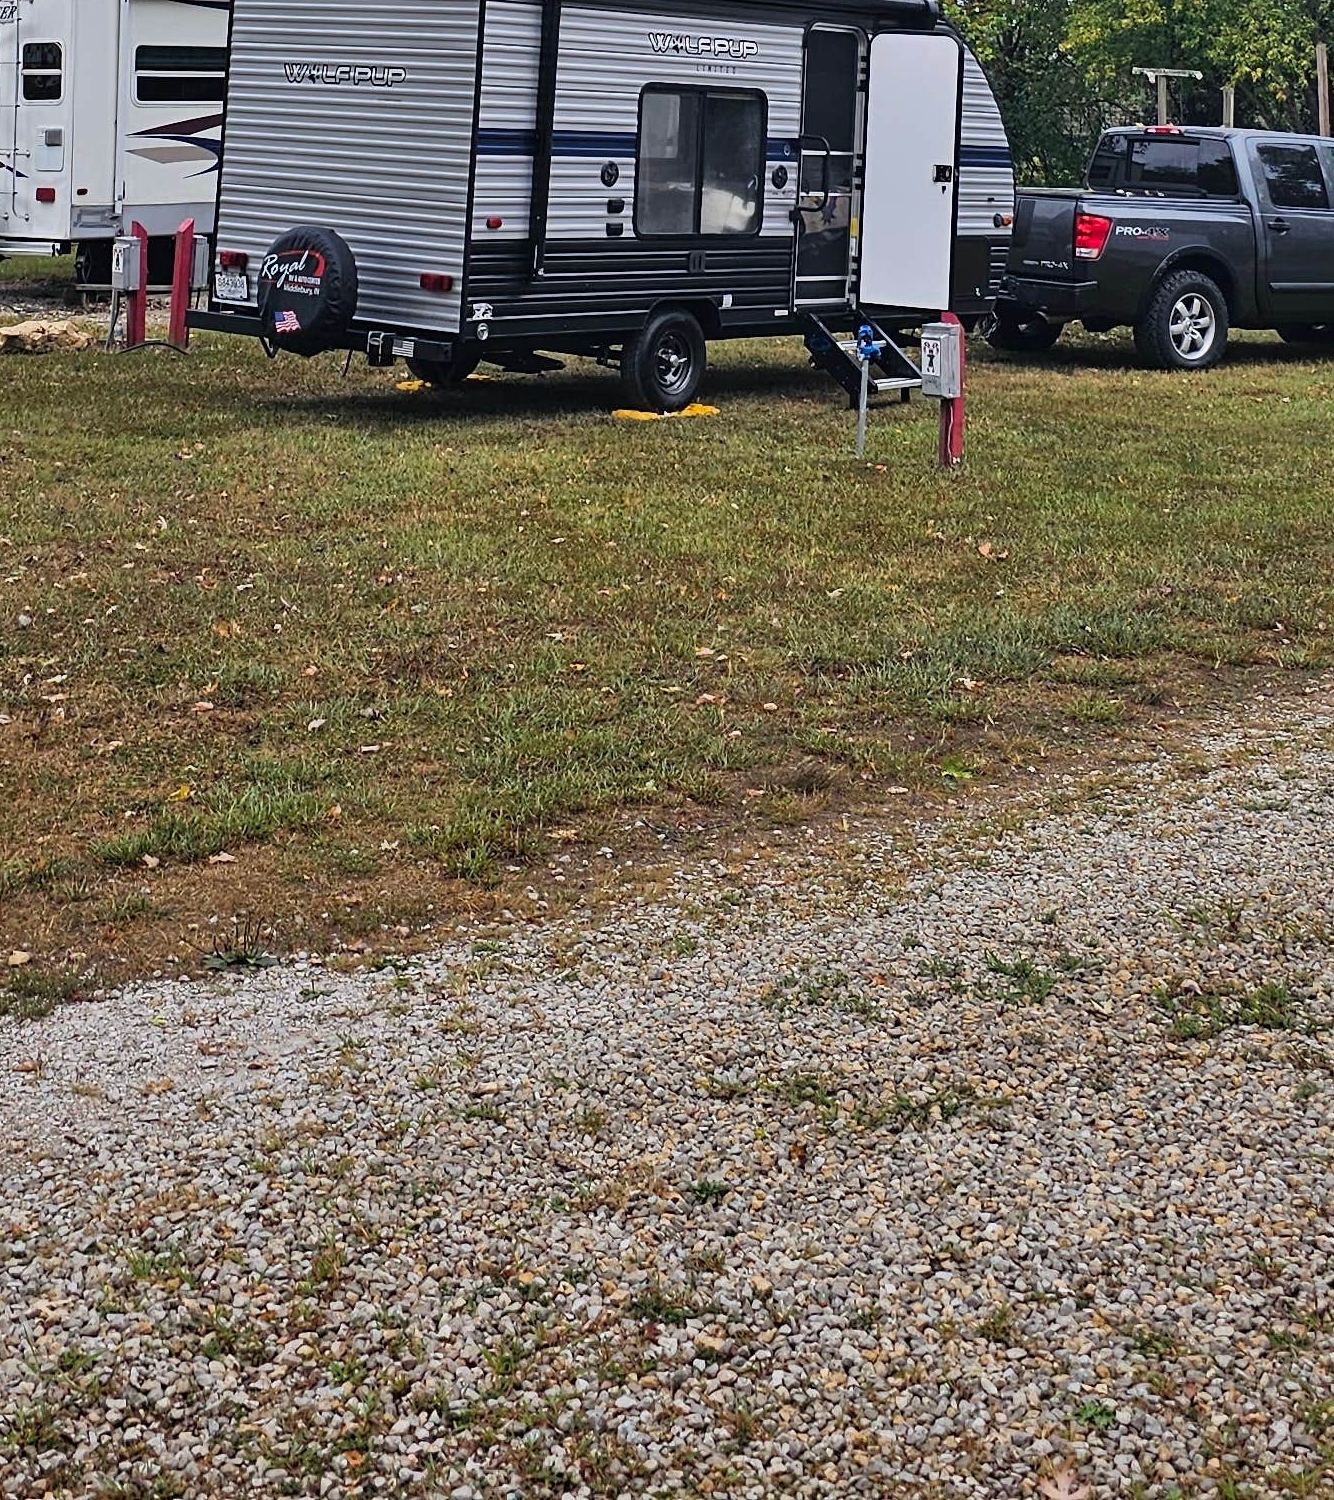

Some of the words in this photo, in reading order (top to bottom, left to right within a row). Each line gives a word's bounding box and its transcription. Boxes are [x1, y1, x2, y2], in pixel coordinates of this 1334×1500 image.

[713, 38, 758, 58] PUP
[354, 66, 406, 87] PUP
[1115, 226, 1170, 238] PRO-4X
[261, 249, 309, 288] Royal
